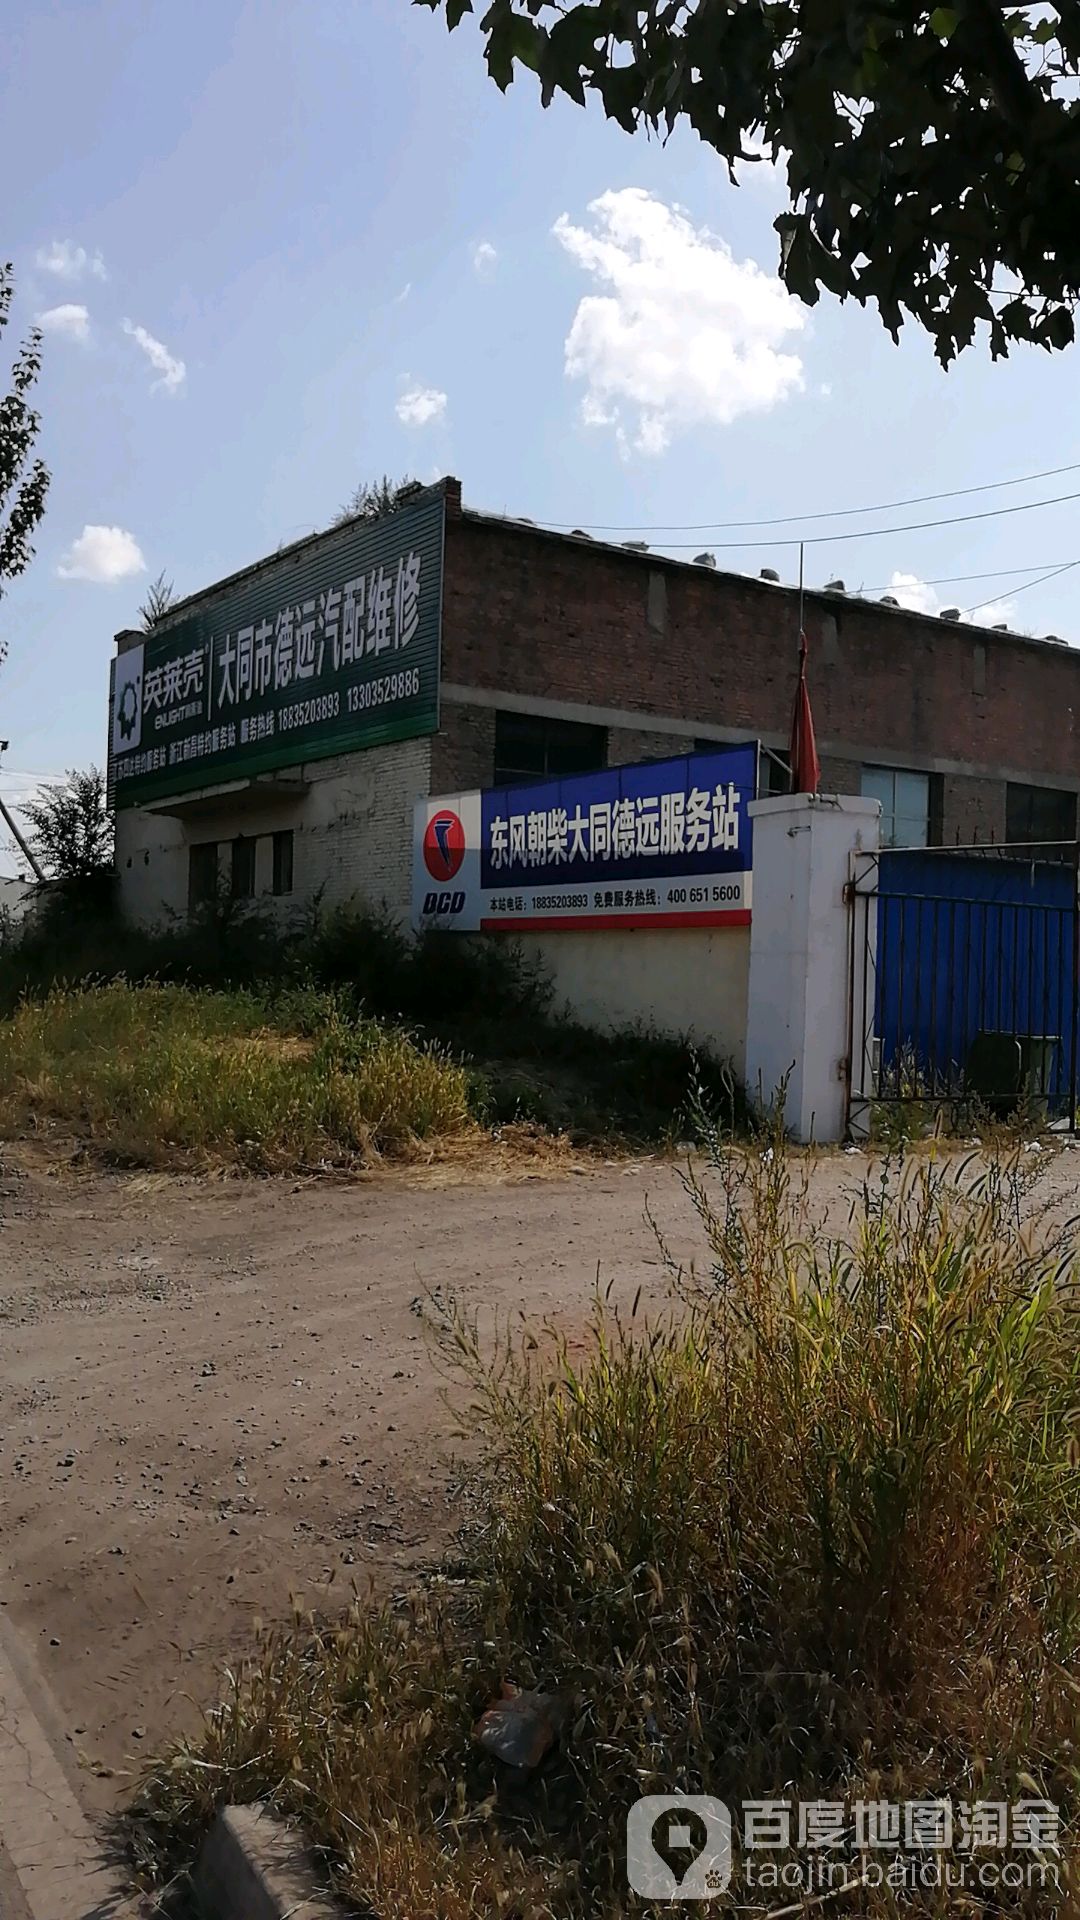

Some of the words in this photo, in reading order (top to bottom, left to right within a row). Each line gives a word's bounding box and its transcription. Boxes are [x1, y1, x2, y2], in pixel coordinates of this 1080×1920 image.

[218, 552, 421, 710] 大同市德远汽配维修
[143, 649, 204, 715] 英莱壳
[241, 710, 276, 745] 服务热线
[279, 692, 340, 731] 18835203893
[347, 668, 420, 713] 13303529886
[490, 781, 741, 870] 东风朝柴大同德远服务站
[422, 891, 467, 915] DCD
